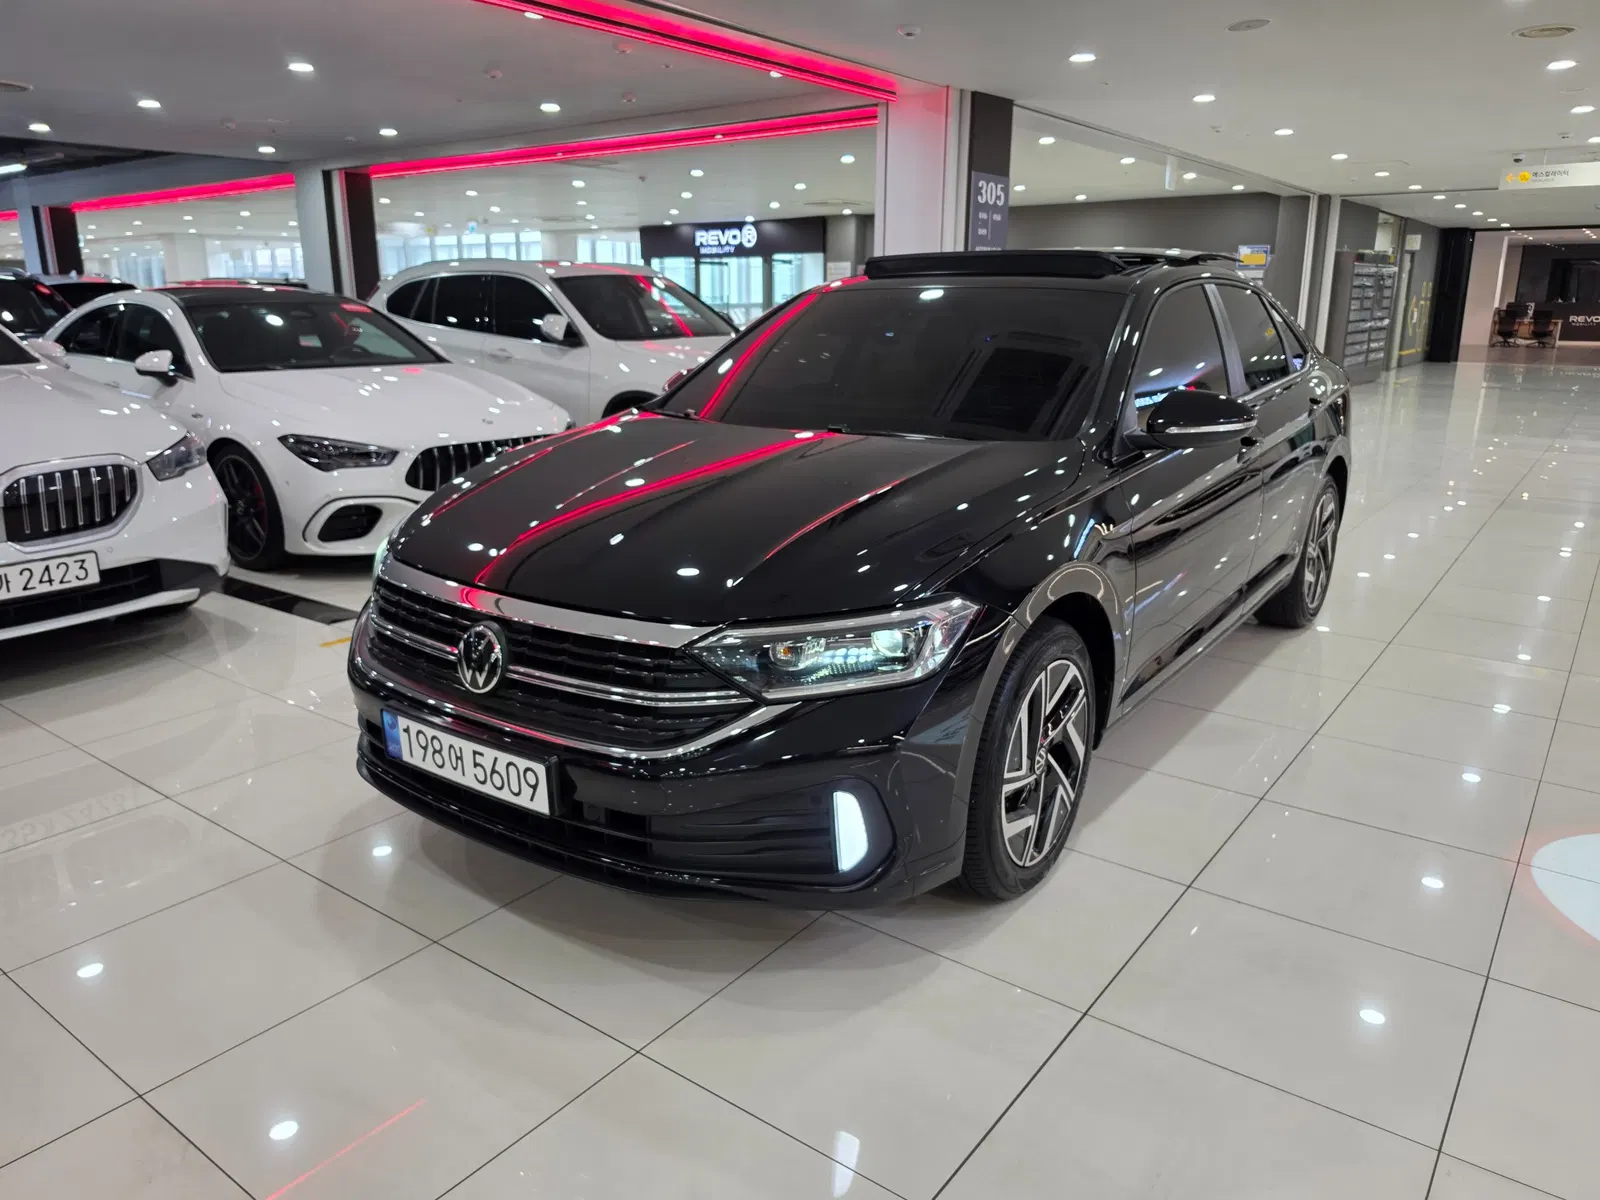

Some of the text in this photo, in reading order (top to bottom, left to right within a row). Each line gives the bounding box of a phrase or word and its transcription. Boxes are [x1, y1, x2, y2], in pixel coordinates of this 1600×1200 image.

[977, 180, 1005, 206] 305
[699, 246, 736, 254] MOBILITY
[1569, 315, 1600, 323] REVO
